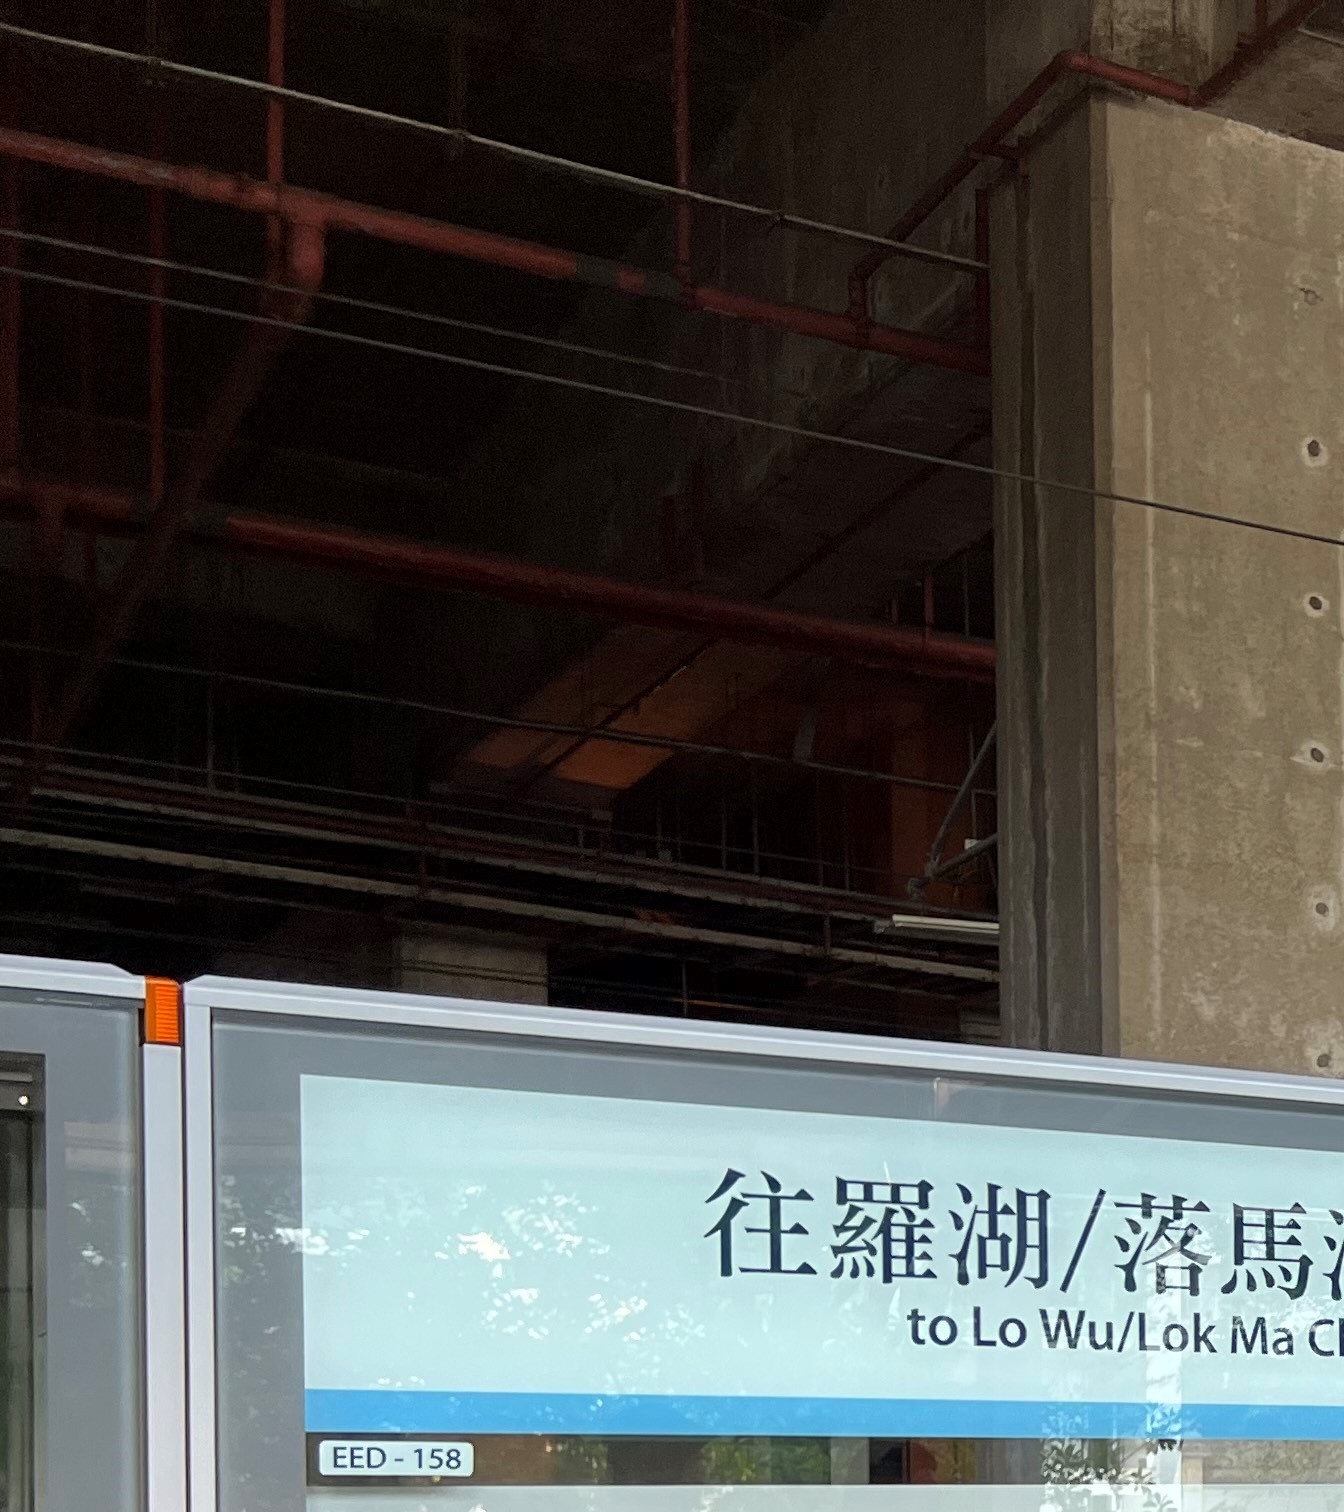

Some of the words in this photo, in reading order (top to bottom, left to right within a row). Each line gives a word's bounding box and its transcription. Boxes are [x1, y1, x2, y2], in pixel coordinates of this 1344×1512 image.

[907, 1309, 957, 1347] to
[973, 1309, 1027, 1348] Lo
[1040, 1307, 1217, 1353] Wu/Lok
[1230, 1316, 1296, 1356] Ma
[333, 1446, 386, 1468] EED
[414, 1448, 461, 1469] 158
